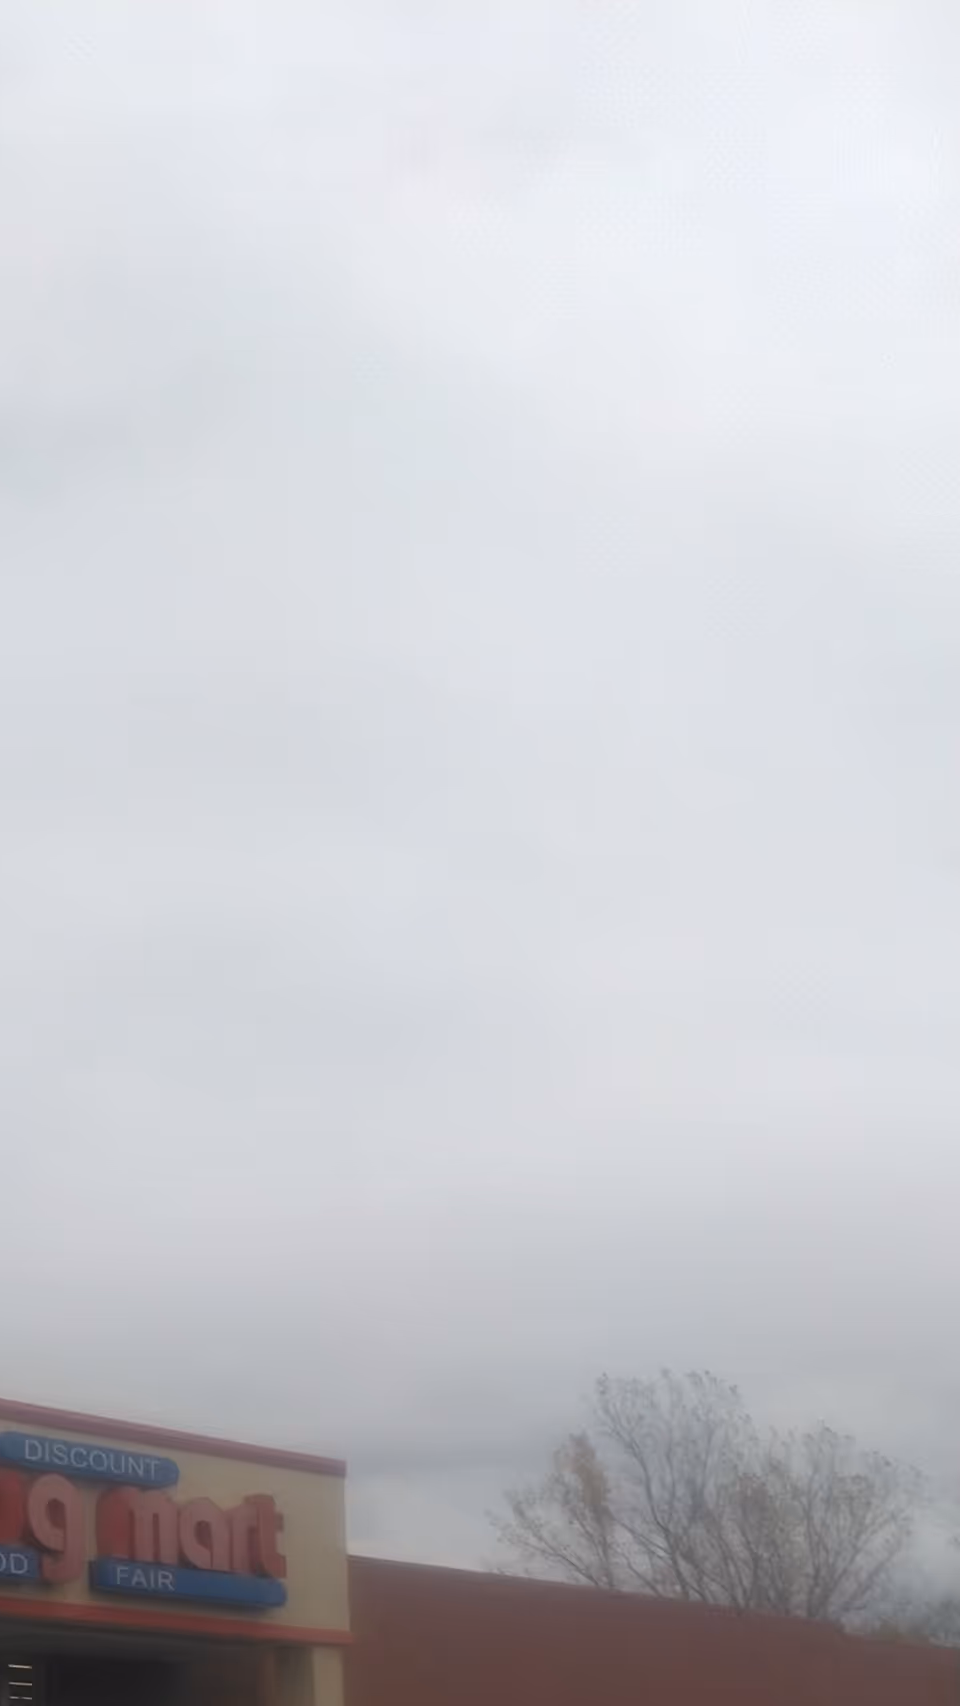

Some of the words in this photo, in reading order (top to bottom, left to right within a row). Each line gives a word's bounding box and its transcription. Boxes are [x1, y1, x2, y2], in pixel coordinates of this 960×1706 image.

[24, 1438, 161, 1480] DISCOUNT
[97, 1487, 287, 1578] mart
[115, 1566, 175, 1591] FAIR
